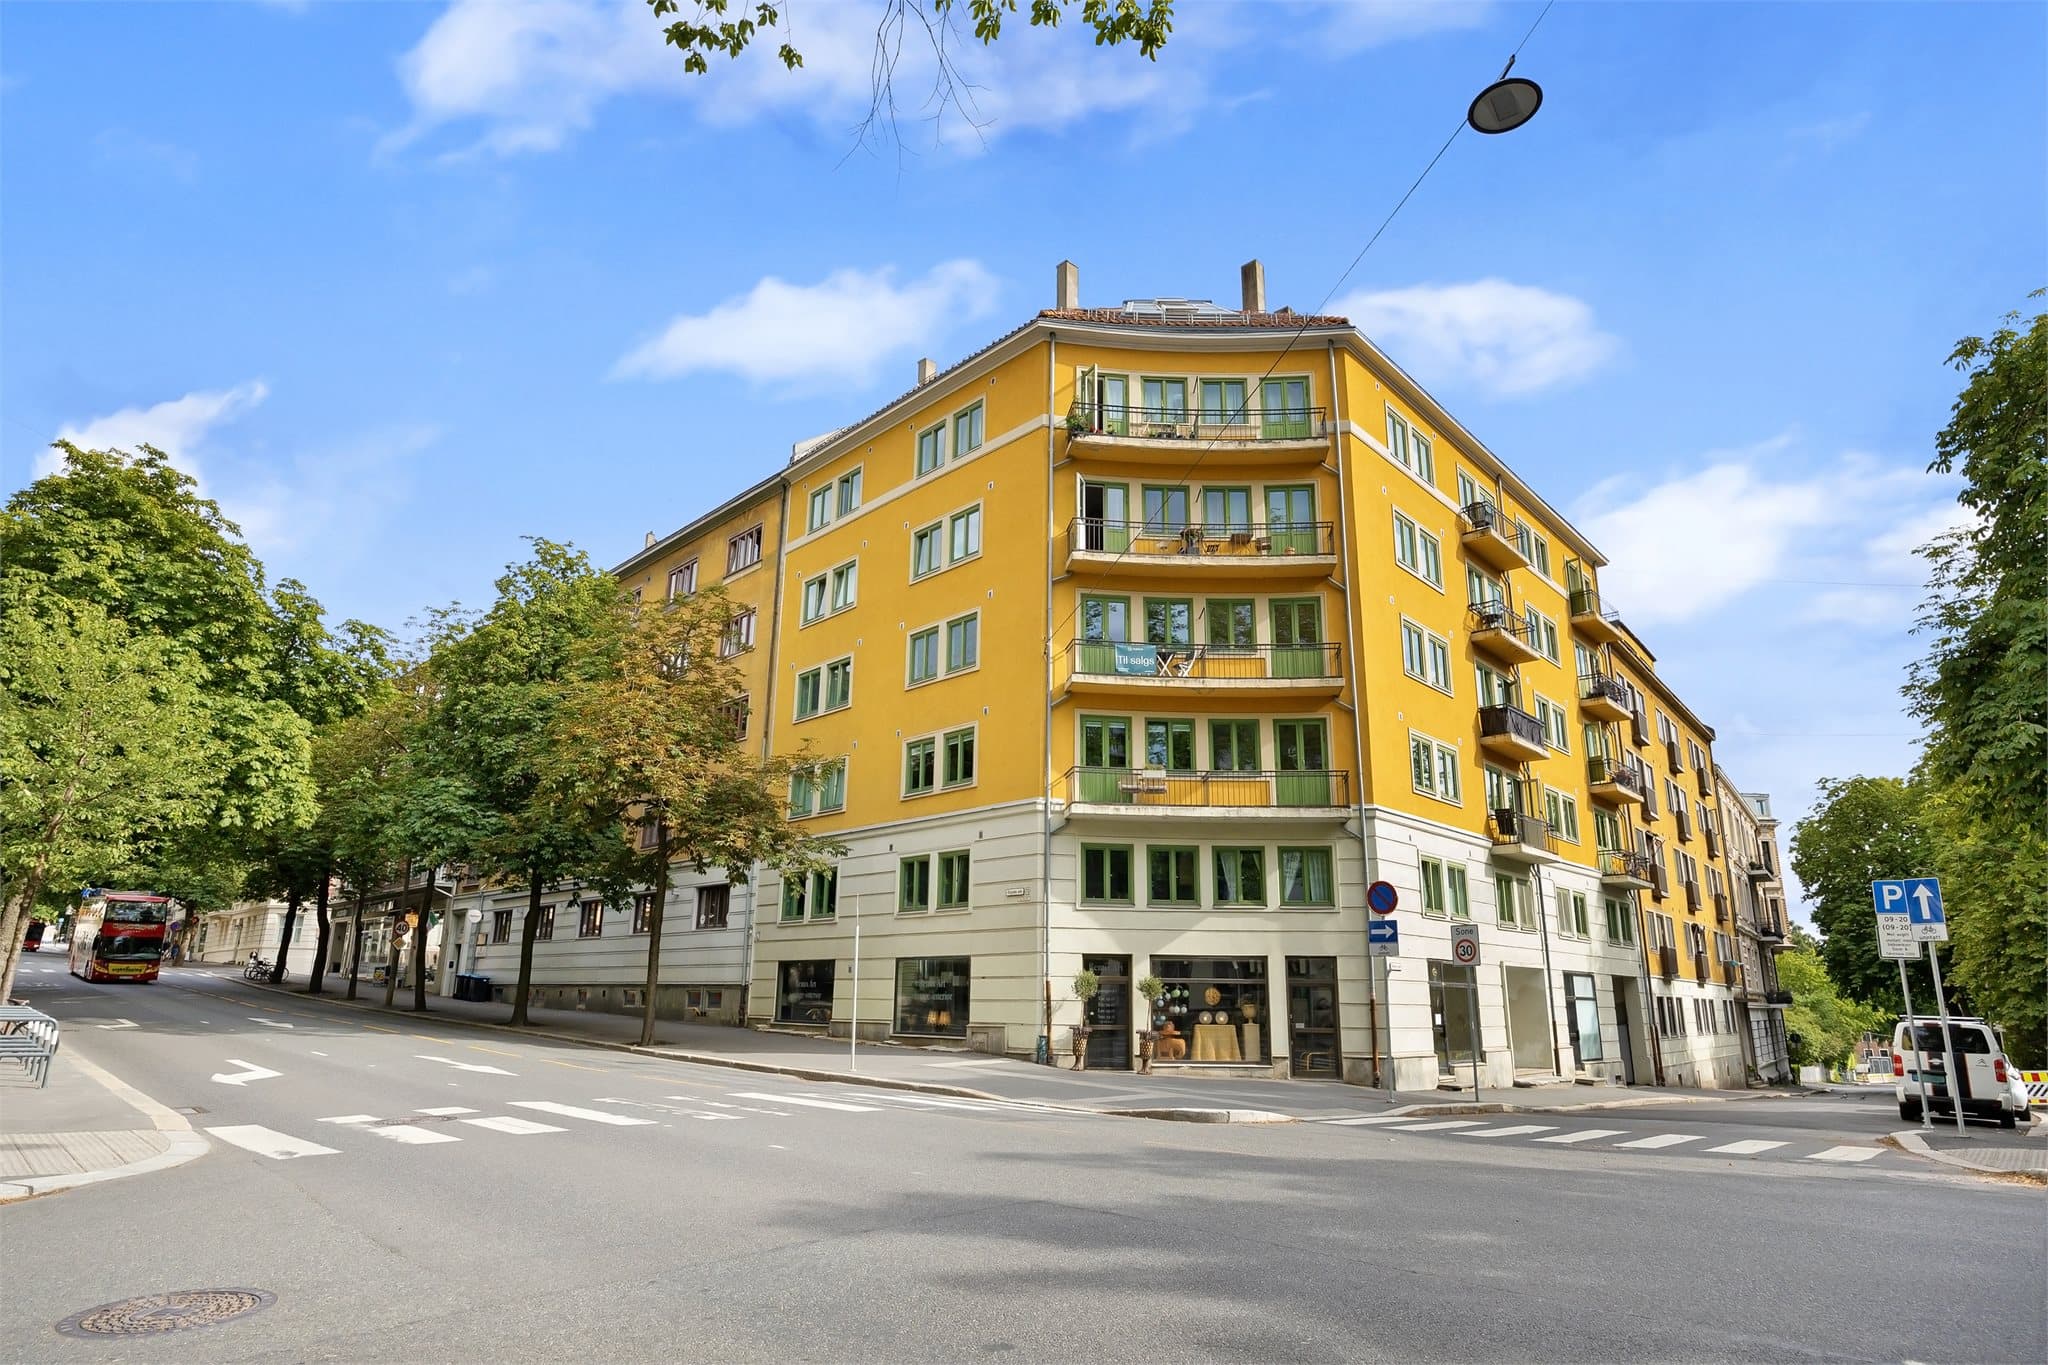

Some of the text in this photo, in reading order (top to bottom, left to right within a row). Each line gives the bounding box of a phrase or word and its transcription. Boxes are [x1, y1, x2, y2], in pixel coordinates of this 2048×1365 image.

[1118, 655, 1155, 667] Til salgs
[1882, 884, 1903, 910] P
[396, 923, 408, 932] 40
[1455, 927, 1474, 936] Sone
[1459, 944, 1473, 957] 30
